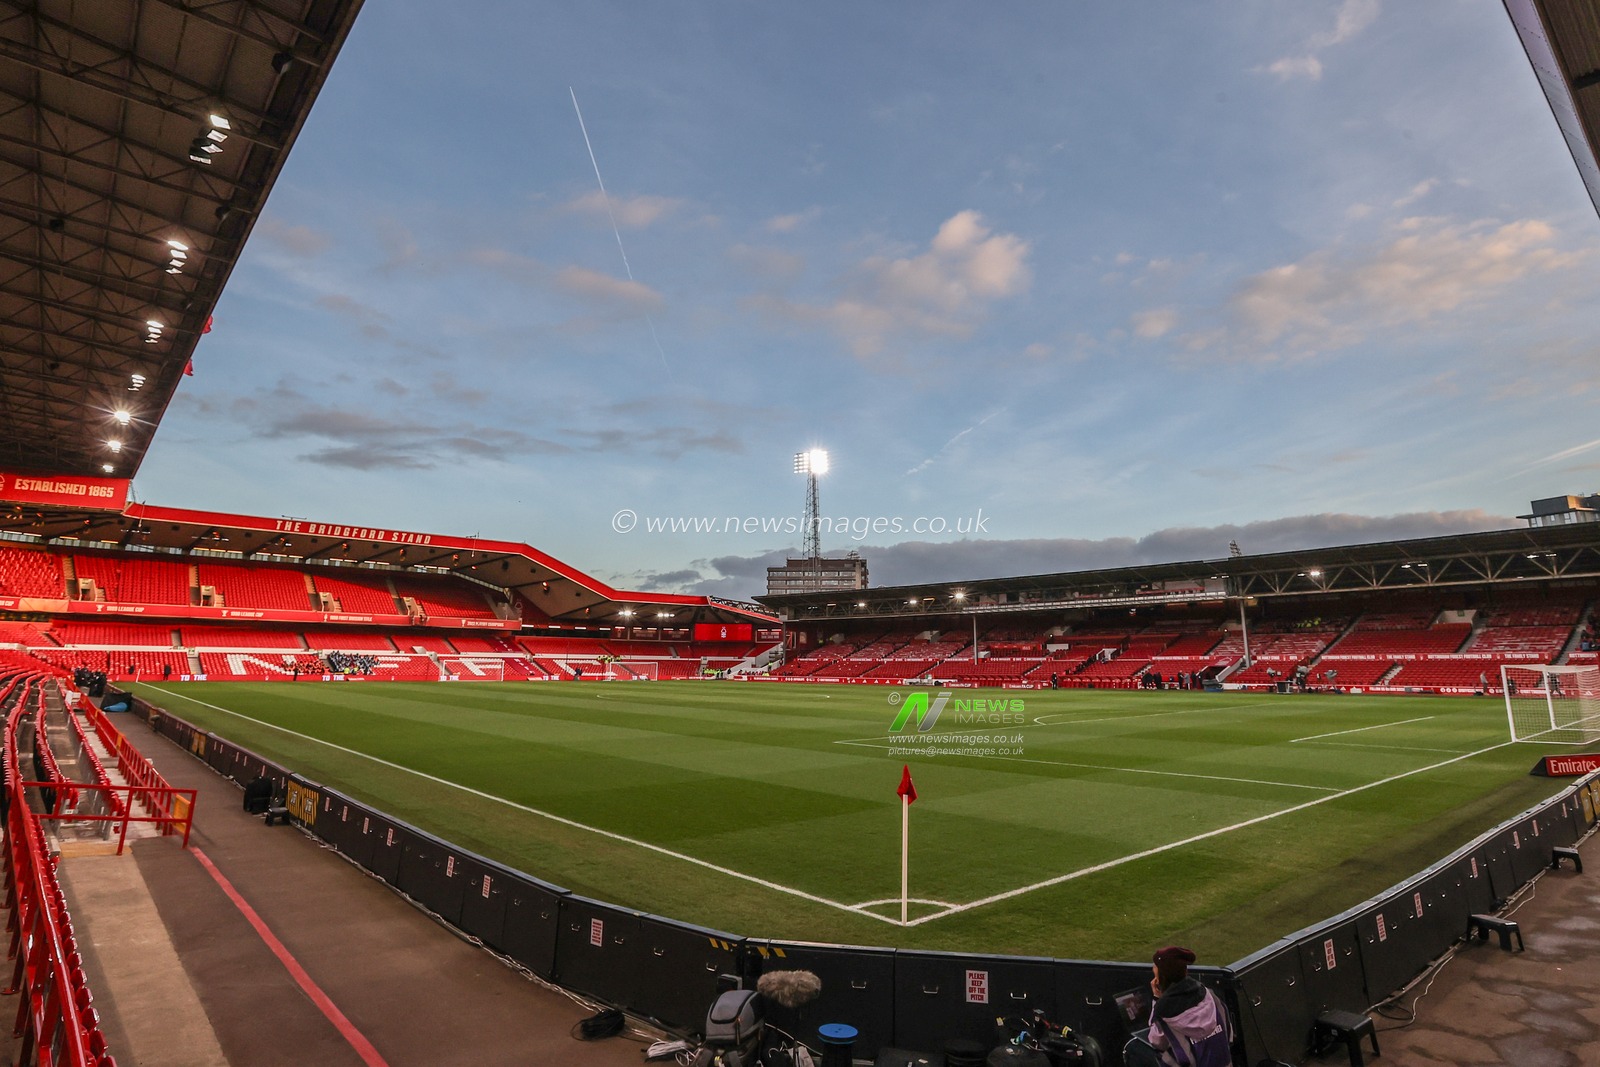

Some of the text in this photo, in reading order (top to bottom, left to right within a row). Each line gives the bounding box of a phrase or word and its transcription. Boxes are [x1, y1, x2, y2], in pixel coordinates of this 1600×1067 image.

[14, 478, 115, 498] ESTABLISHED 1865
[276, 520, 432, 545] THE BRIDGFORD STAND
[1549, 758, 1598, 774] Emirates
